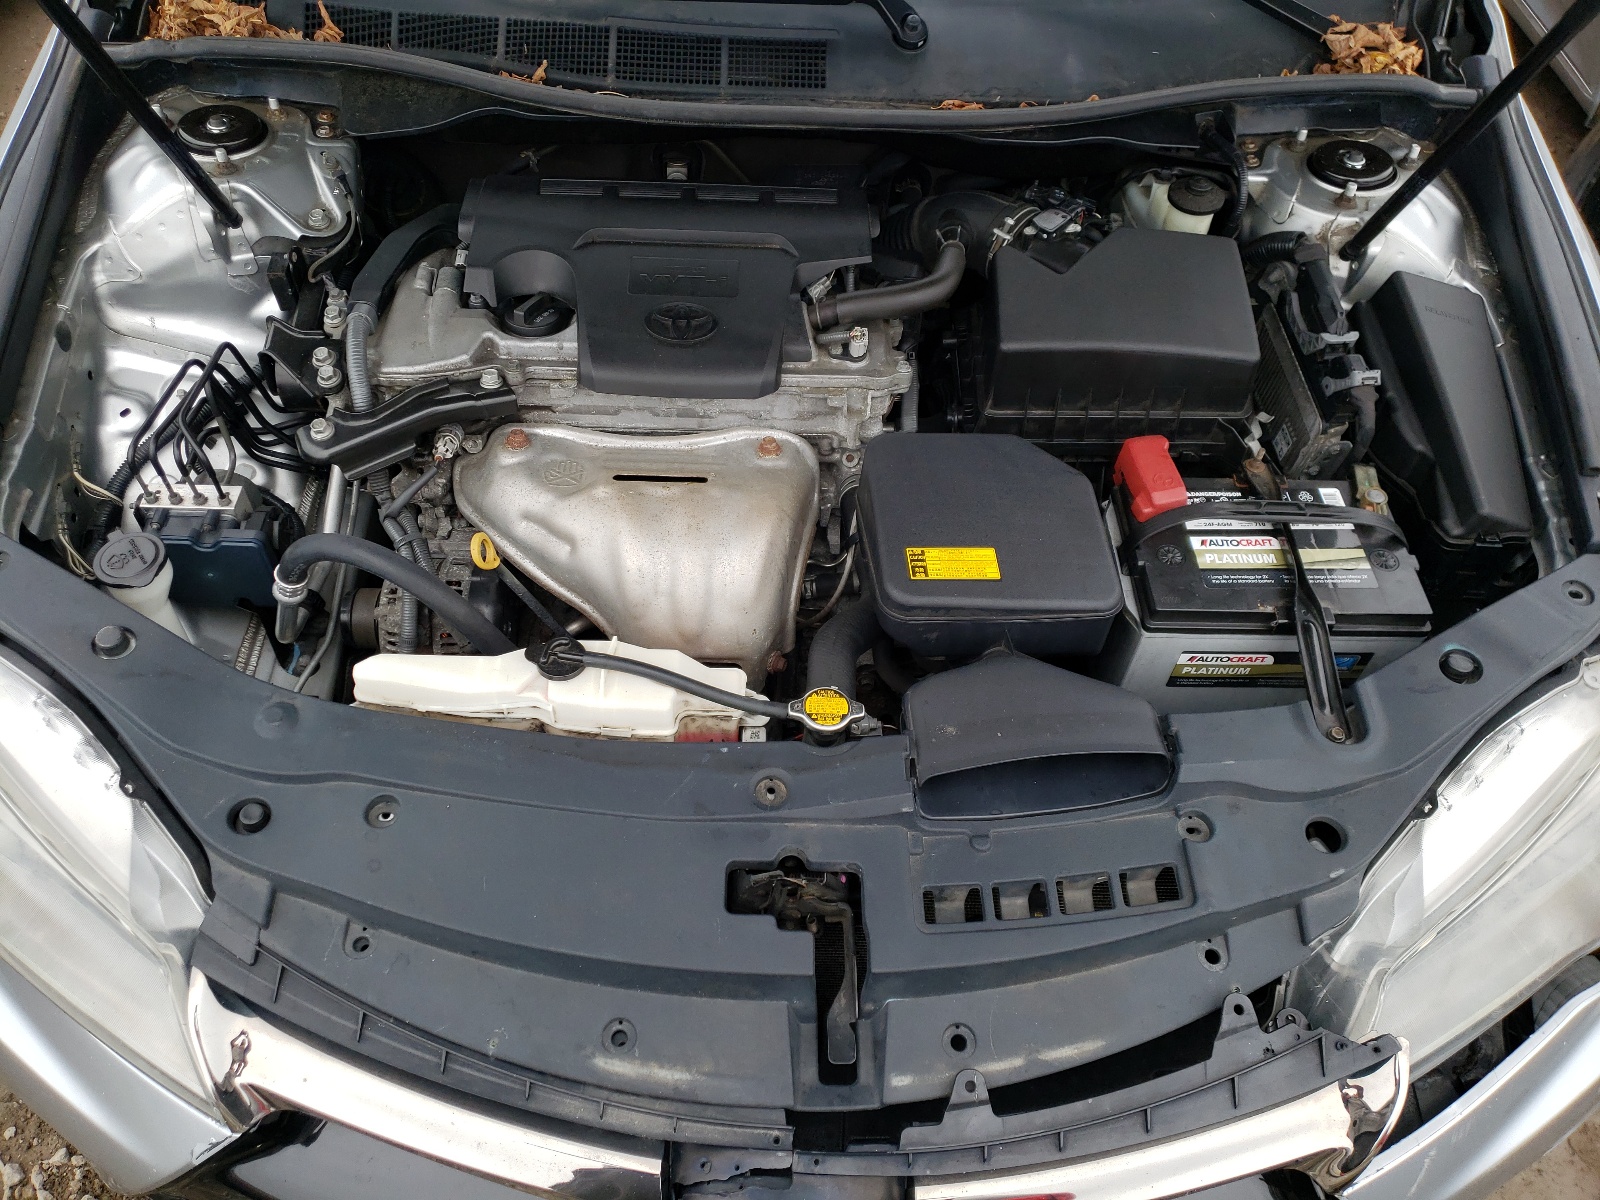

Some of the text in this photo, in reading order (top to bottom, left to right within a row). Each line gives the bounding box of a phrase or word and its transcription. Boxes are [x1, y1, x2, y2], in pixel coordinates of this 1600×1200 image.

[1208, 539, 1273, 547] AUTOCRAFT
[1205, 553, 1277, 564] PLATINUM
[1181, 666, 1252, 675] PLATINUM
